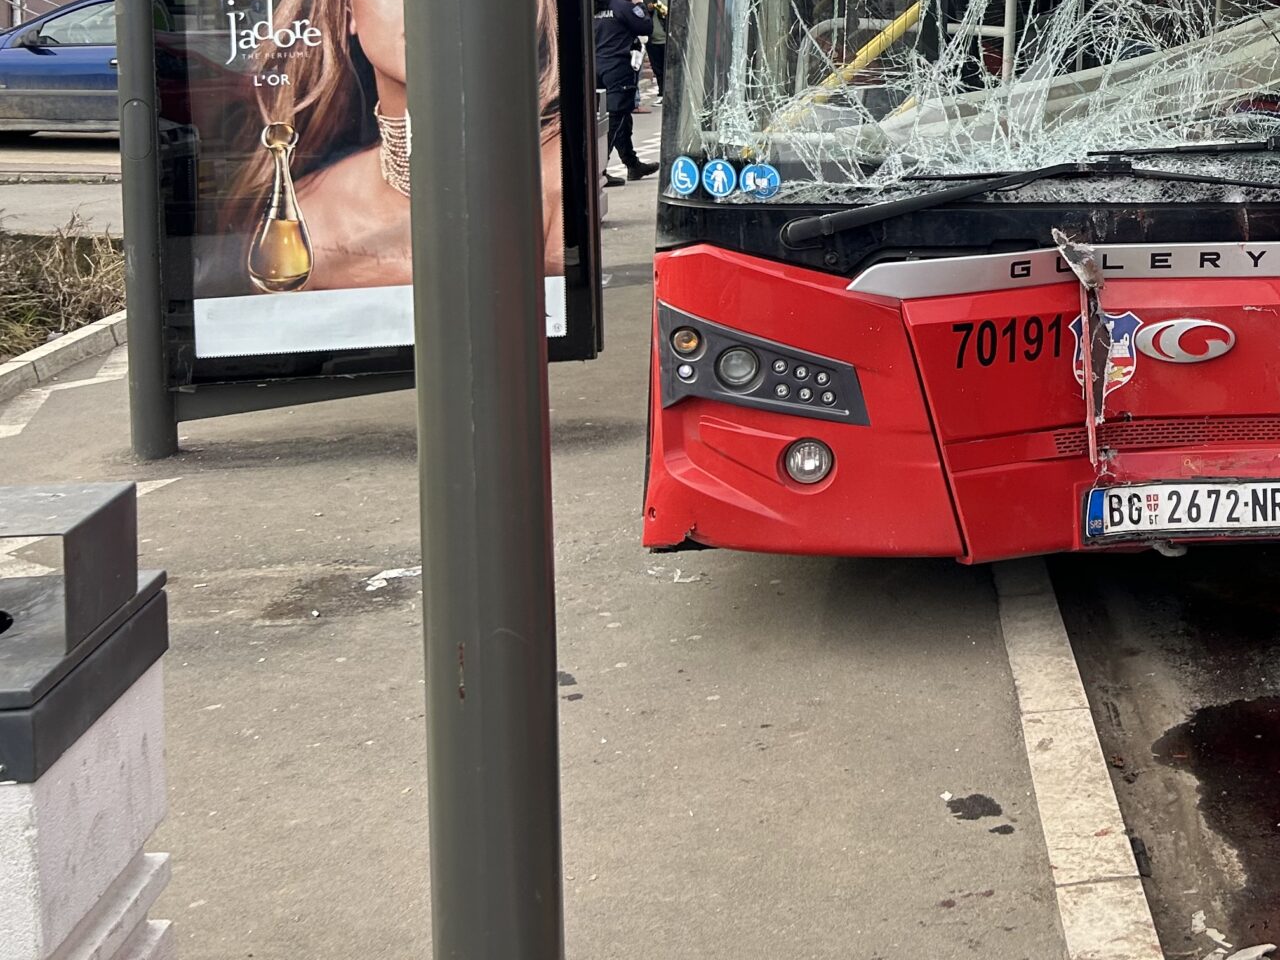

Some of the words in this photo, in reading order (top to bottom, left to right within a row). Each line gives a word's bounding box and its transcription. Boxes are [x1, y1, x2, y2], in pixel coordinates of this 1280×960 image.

[253, 74, 291, 87] L'OR
[952, 313, 1063, 369] 70191
[1108, 493, 1143, 527] BG
